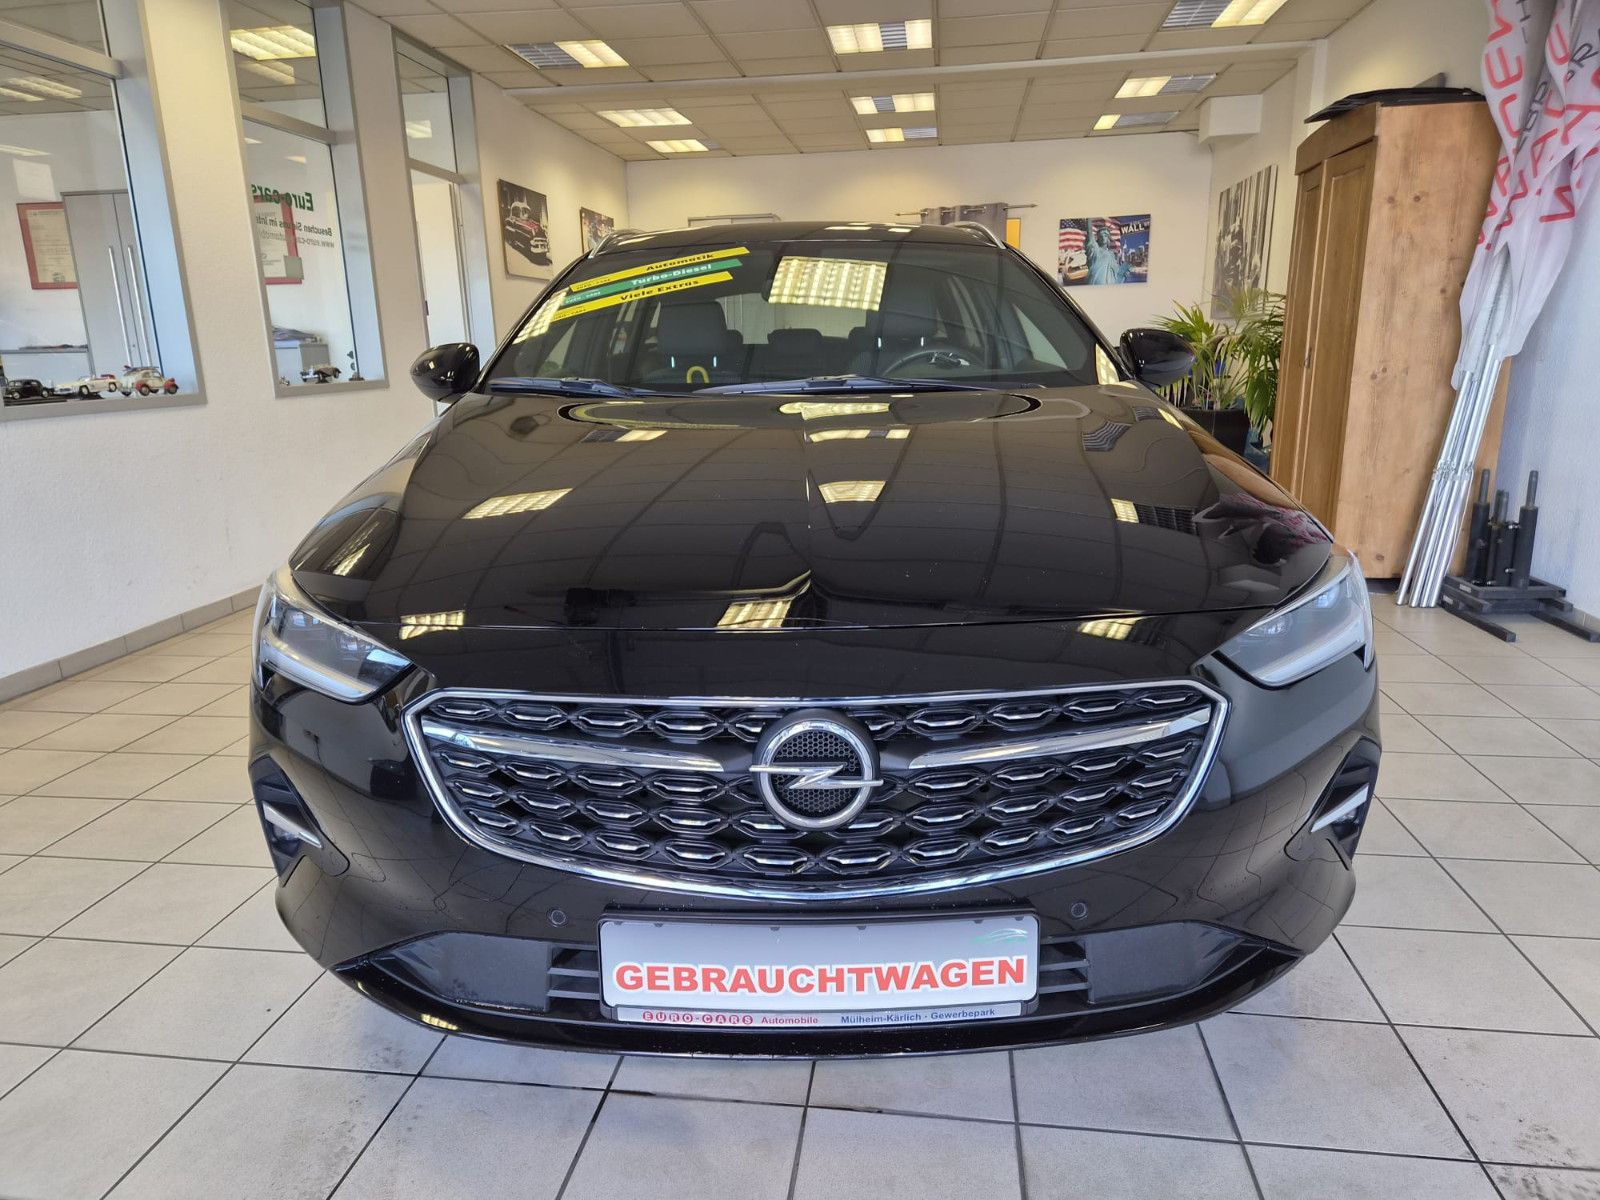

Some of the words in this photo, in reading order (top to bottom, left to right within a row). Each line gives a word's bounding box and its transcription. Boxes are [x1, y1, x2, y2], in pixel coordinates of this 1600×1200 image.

[1120, 223, 1144, 234] WALL
[646, 253, 714, 271] Automatik
[631, 263, 712, 286] Turbo-Diesel
[620, 288, 653, 300] Viele
[657, 280, 699, 292] Extras
[614, 957, 1026, 995] GEBRAUCHTWAGEN
[761, 1015, 818, 1025] Automobile
[841, 1012, 921, 1024] Mülheim-Kärlich
[930, 1008, 995, 1020] Gewerbepark
